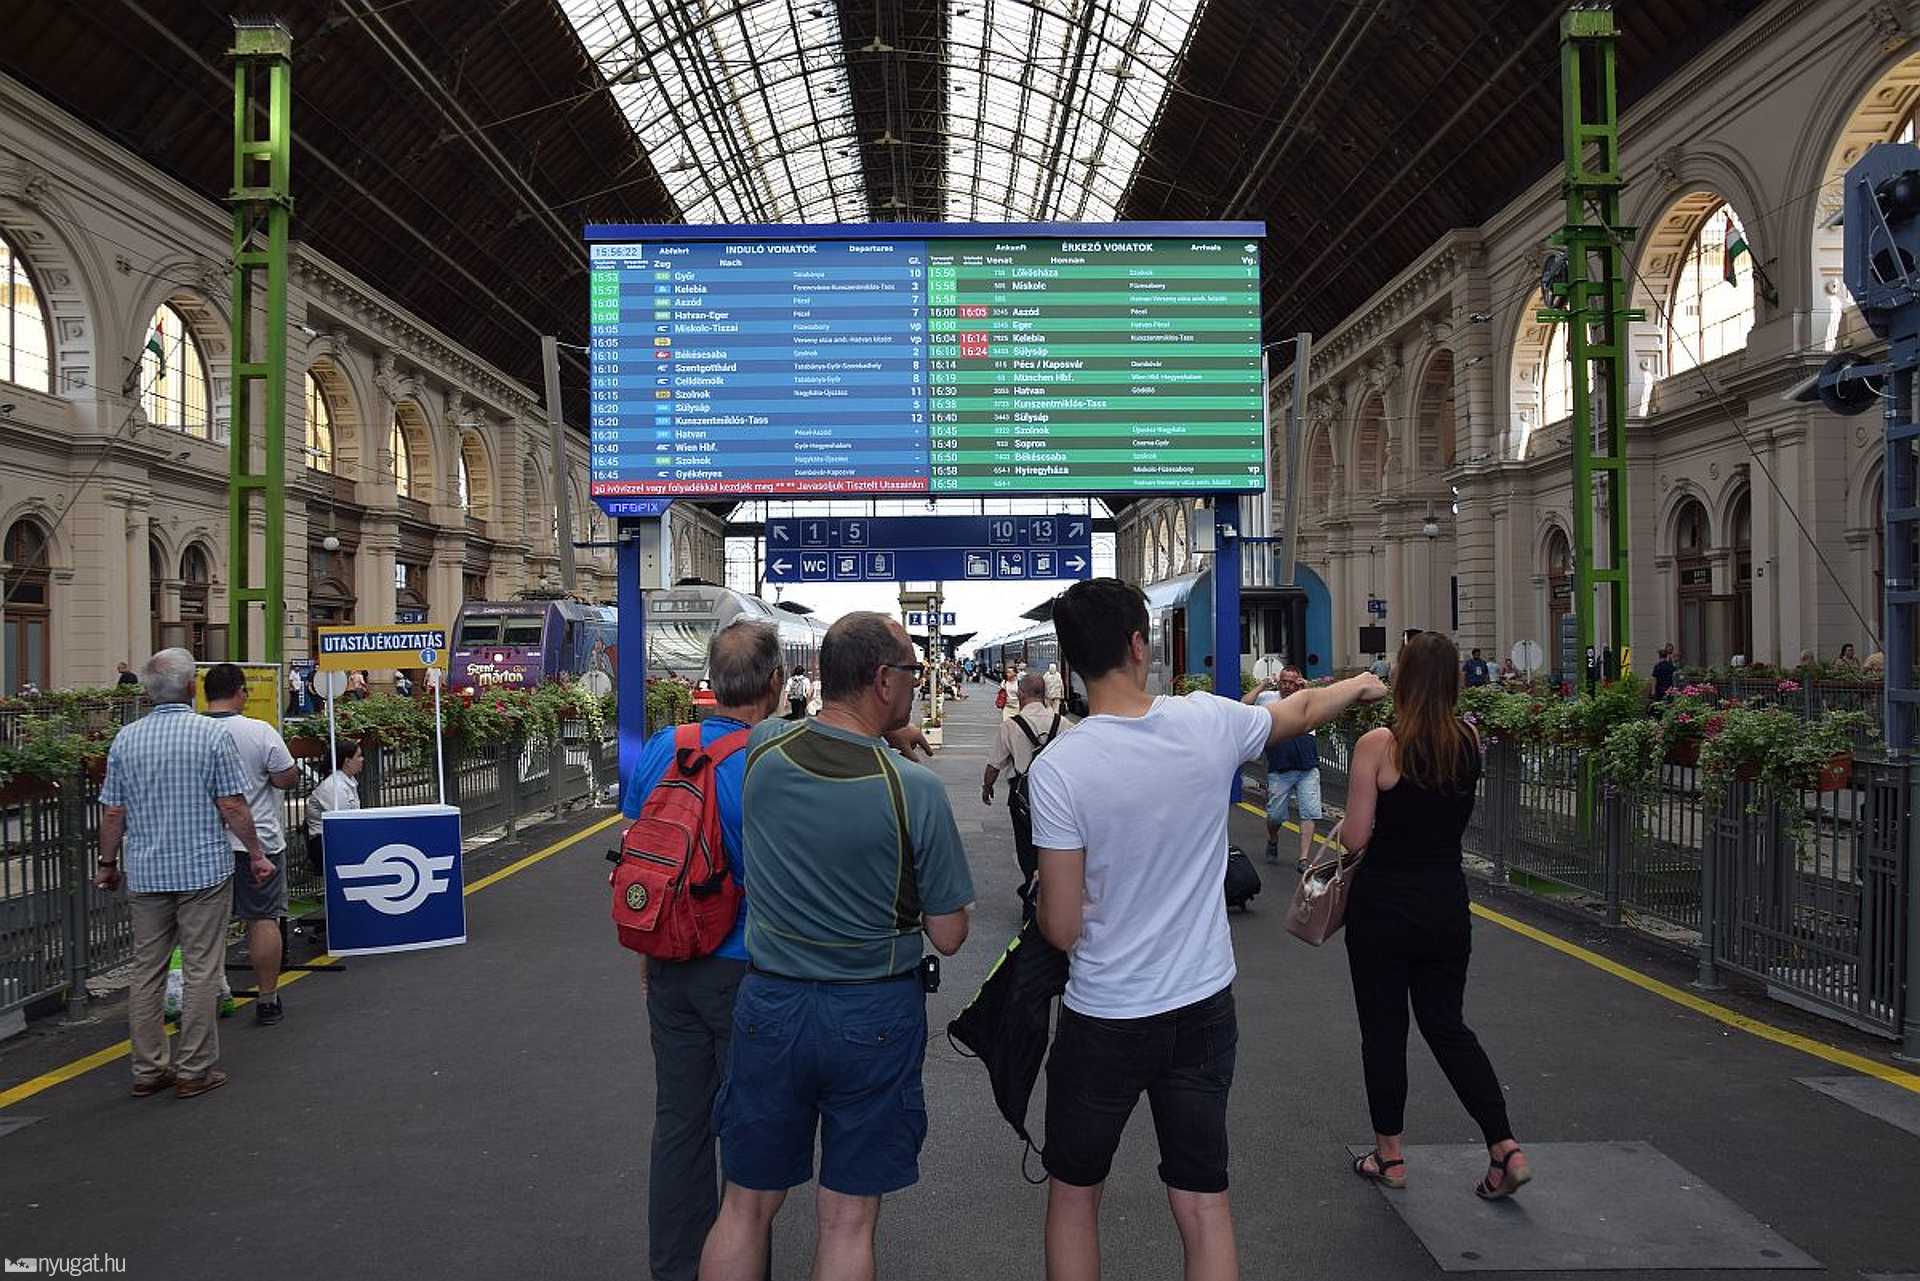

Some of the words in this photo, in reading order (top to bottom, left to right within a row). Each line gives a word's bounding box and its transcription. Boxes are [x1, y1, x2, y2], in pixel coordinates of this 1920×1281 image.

[659, 247, 689, 255] Abfahrt
[726, 245, 765, 254] INDULÓ
[768, 245, 817, 254] VONATOK
[1062, 242, 1101, 251] ÉRKEZŐ
[1104, 243, 1153, 251] VONATOK
[654, 260, 671, 269] Zug
[720, 259, 742, 267] Nach
[674, 272, 695, 281] Győr
[910, 269, 921, 277] 10
[674, 285, 707, 293] Kelebia
[1012, 281, 1046, 290] Miskolc
[592, 299, 618, 308] 16:00
[675, 297, 702, 306] Aszód
[912, 295, 919, 303] 7
[592, 312, 618, 321] 16:00
[674, 312, 729, 321] Hatvan-Eger
[912, 308, 919, 317] 7
[930, 309, 956, 317] 16:00
[1013, 307, 1040, 316] Aszód
[593, 325, 618, 334] 16:05
[674, 324, 738, 333] Miskolc-Tiszai
[930, 321, 956, 330] 16:00
[1012, 322, 1032, 331] Eger
[593, 338, 619, 347] 16:05
[930, 334, 956, 343] 16:04
[961, 334, 987, 343] 16:14
[1013, 334, 1045, 343] Kelebia
[593, 351, 618, 360] 16:10
[675, 350, 727, 359] Békéscsaba
[913, 348, 919, 356] 2
[930, 347, 956, 356] 16:10
[961, 347, 987, 356] 16:24
[593, 365, 618, 374] 16:10
[674, 363, 737, 373] Szentgotthárd
[913, 361, 919, 370] 8
[931, 360, 956, 370] 16:14
[1014, 360, 1035, 369] Pécs
[1043, 360, 1084, 370] Kaposvár
[593, 378, 618, 387] 16:10
[913, 374, 919, 383] 8
[931, 374, 956, 383] 16:19
[1014, 373, 1053, 382] München
[593, 391, 618, 400] 16:15
[675, 390, 711, 399] Szolnok
[931, 386, 957, 396] 16:30
[1014, 387, 1045, 395] Hatvan
[593, 404, 618, 413] 16:20
[675, 415, 768, 425] Kunszentmiklós-Tass
[911, 414, 923, 423] 12
[931, 413, 957, 422] 16:40
[1014, 413, 1049, 422] Sülysáp
[675, 430, 706, 439] Hatvan
[931, 426, 957, 435] 16:45
[1014, 426, 1050, 435] Szolnok
[593, 444, 618, 453] 16:40
[675, 443, 698, 452] Wien
[931, 439, 957, 448] 16:49
[1014, 440, 1046, 449] Sopron
[593, 457, 619, 466] 16:45
[675, 457, 712, 465] Szolnok
[932, 452, 957, 461] 16:50
[1015, 452, 1066, 461] Békéscsaba
[593, 470, 618, 479] 16:45
[675, 470, 723, 479] Gyékényes
[932, 466, 957, 475] 16:58
[1015, 466, 1069, 475] Nyíregyháza
[646, 484, 666, 494] vagy
[720, 480, 753, 492] kezdjék
[755, 483, 774, 493] meg
[797, 481, 843, 492] Javasoljuk
[847, 480, 878, 490] Tisztelt
[932, 479, 957, 488] 16:58
[808, 523, 818, 539] 1
[849, 523, 860, 539] 5
[993, 521, 1013, 538] 10
[1032, 521, 1052, 538] 13
[803, 561, 826, 572] WC
[324, 631, 442, 652] UTASTÁJÉKOZTATÁS
[467, 663, 495, 675] Szent
